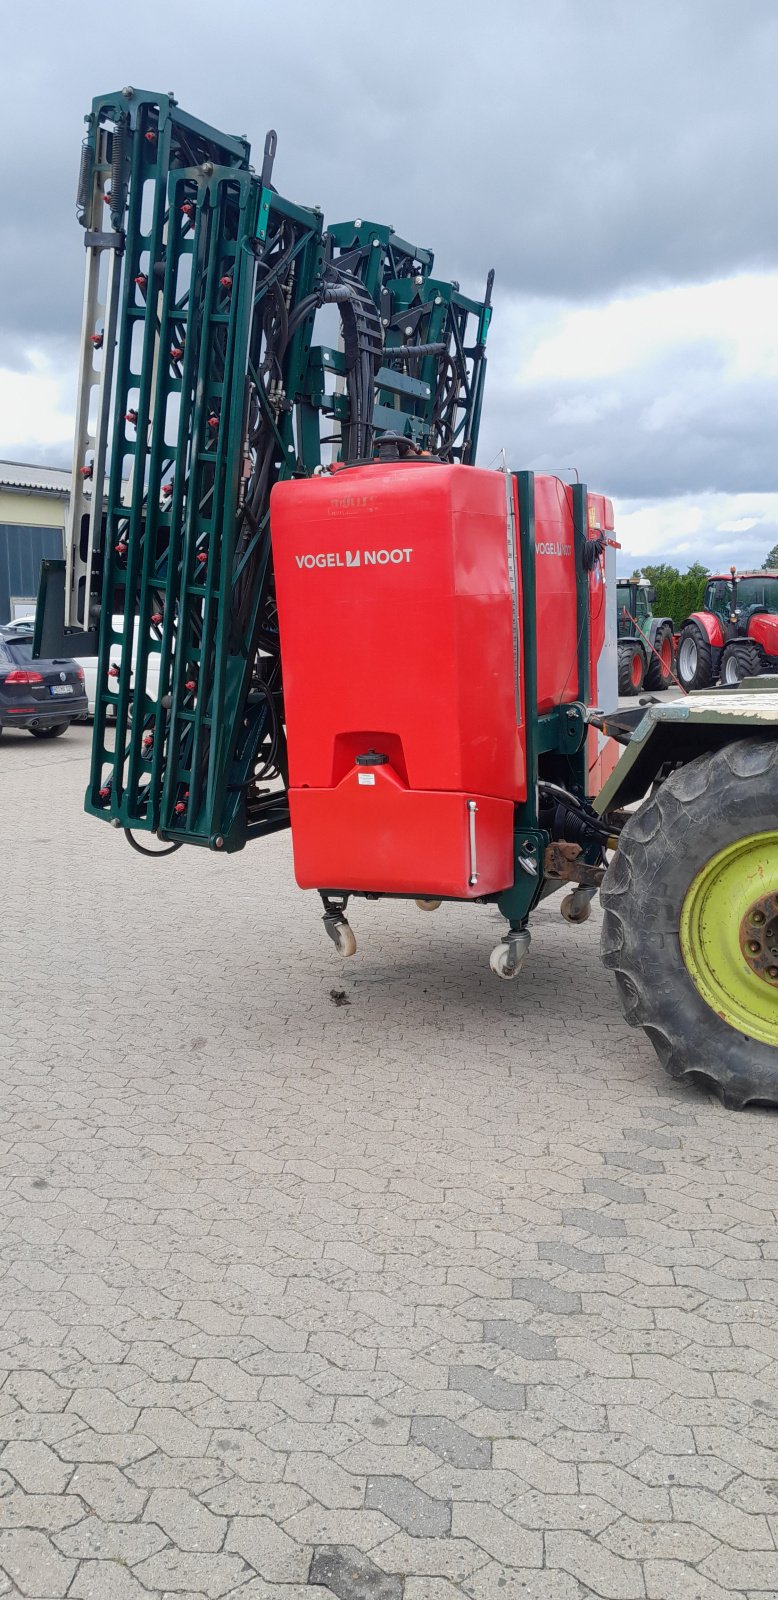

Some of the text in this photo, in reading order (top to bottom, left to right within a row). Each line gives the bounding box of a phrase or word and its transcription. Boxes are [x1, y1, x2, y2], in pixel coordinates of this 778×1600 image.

[535, 542, 557, 554] VOGEL
[295, 548, 413, 569] VOGEL NOOT
